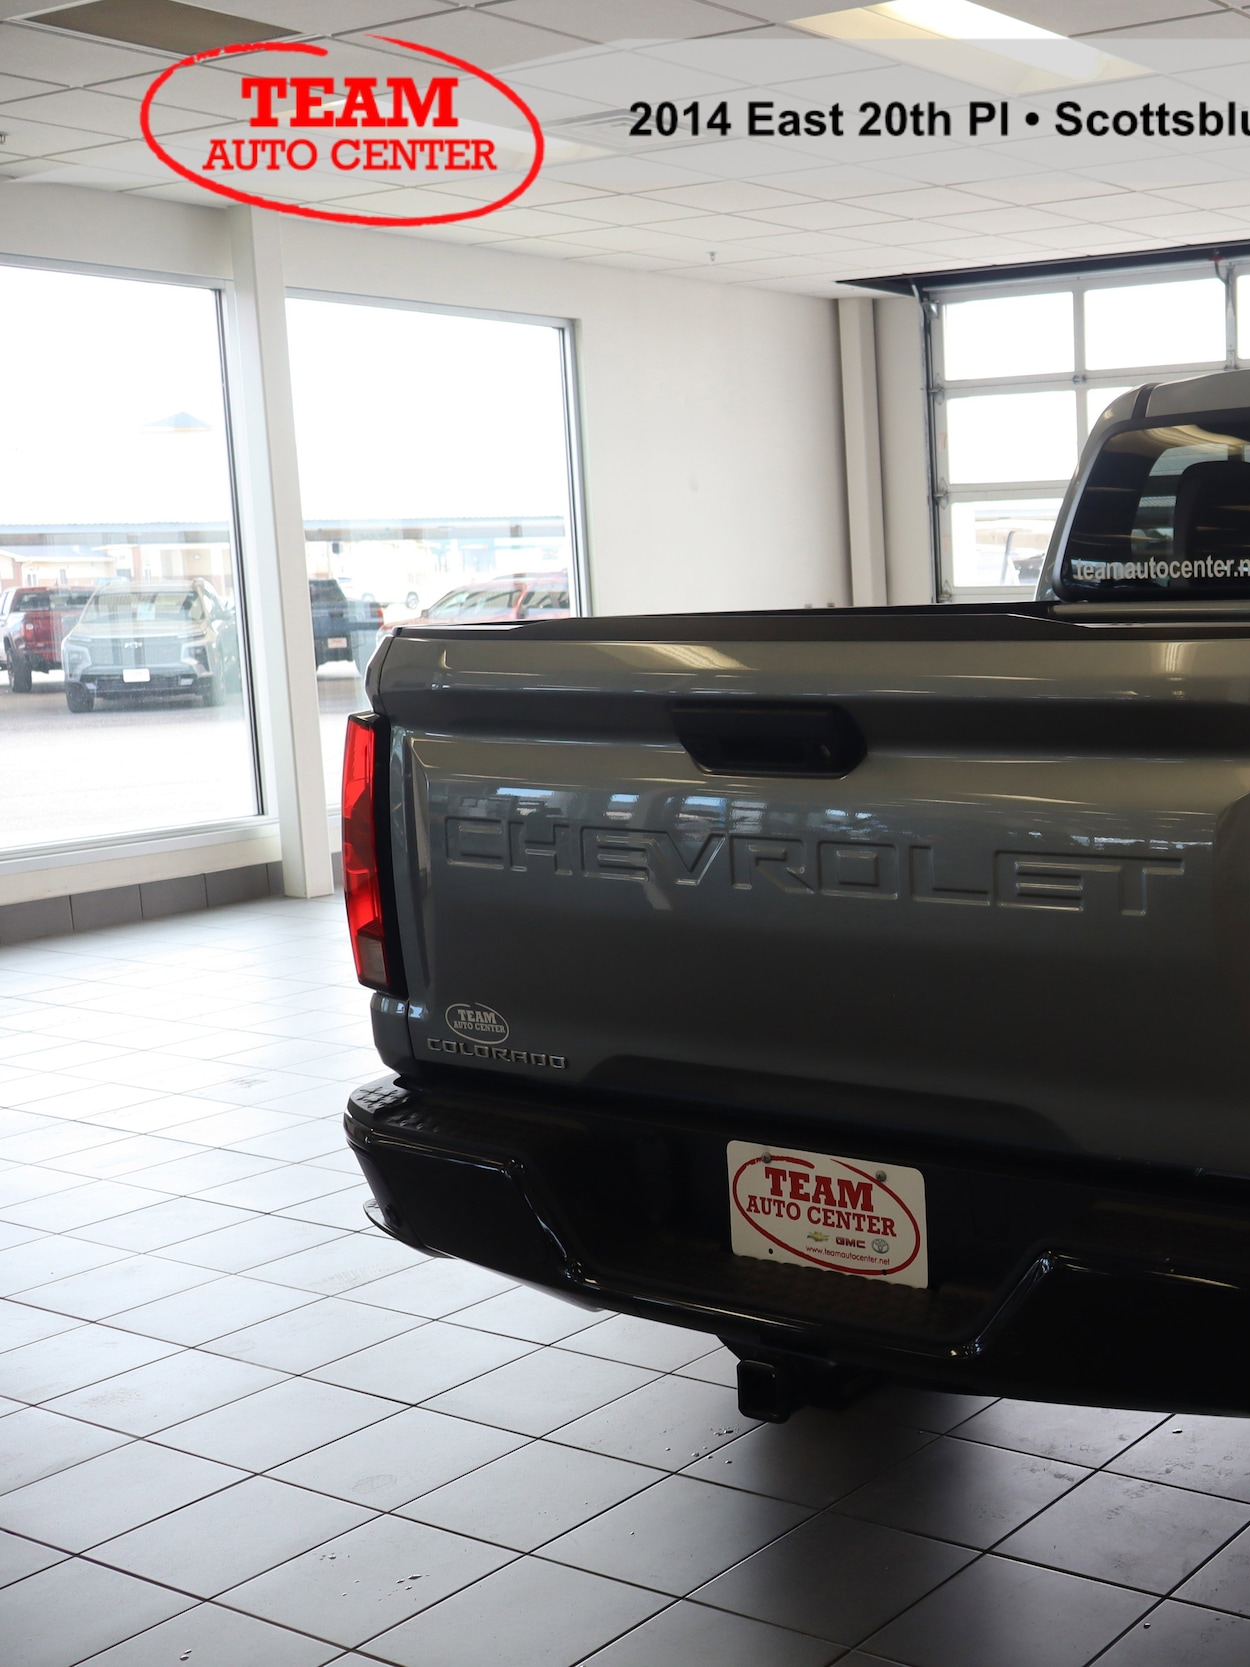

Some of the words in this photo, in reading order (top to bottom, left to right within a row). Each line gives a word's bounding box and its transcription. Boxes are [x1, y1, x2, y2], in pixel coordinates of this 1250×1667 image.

[444, 815, 1187, 917] CHEVROLET
[453, 1020, 474, 1031] AUTO
[474, 1023, 506, 1034] CENTER
[457, 1009, 497, 1025] TEAM
[426, 1038, 566, 1069] COLORADO
[764, 1166, 874, 1213] TEAM
[746, 1194, 801, 1221] AUTO
[806, 1205, 898, 1238] CENTER
[805, 1245, 891, 1266] www.teamautocenter.net
[835, 1236, 866, 1249] GMC
